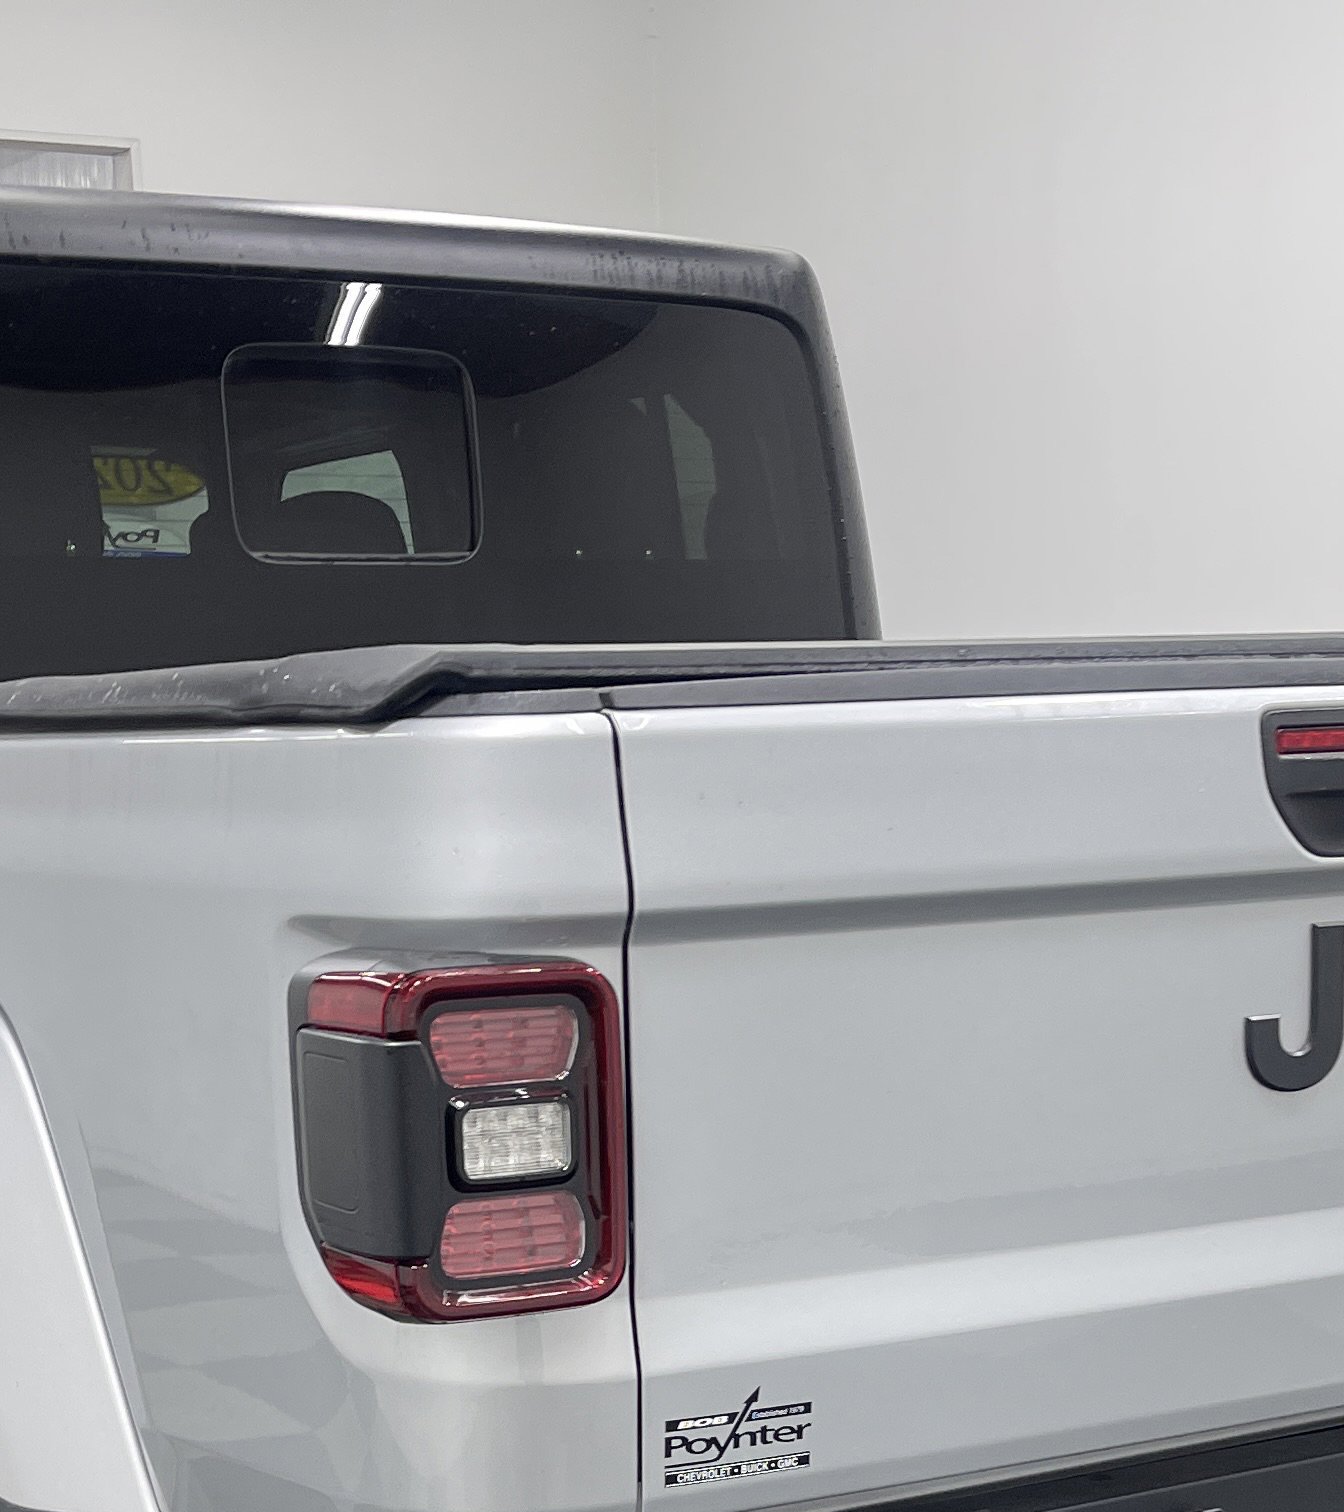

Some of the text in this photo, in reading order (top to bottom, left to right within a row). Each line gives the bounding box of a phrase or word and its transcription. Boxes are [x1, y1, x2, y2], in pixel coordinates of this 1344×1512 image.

[676, 1415, 730, 1430] BOB
[664, 1421, 812, 1465] Poynter
[676, 1456, 799, 1483] CHEVROLET BUICK GMC
